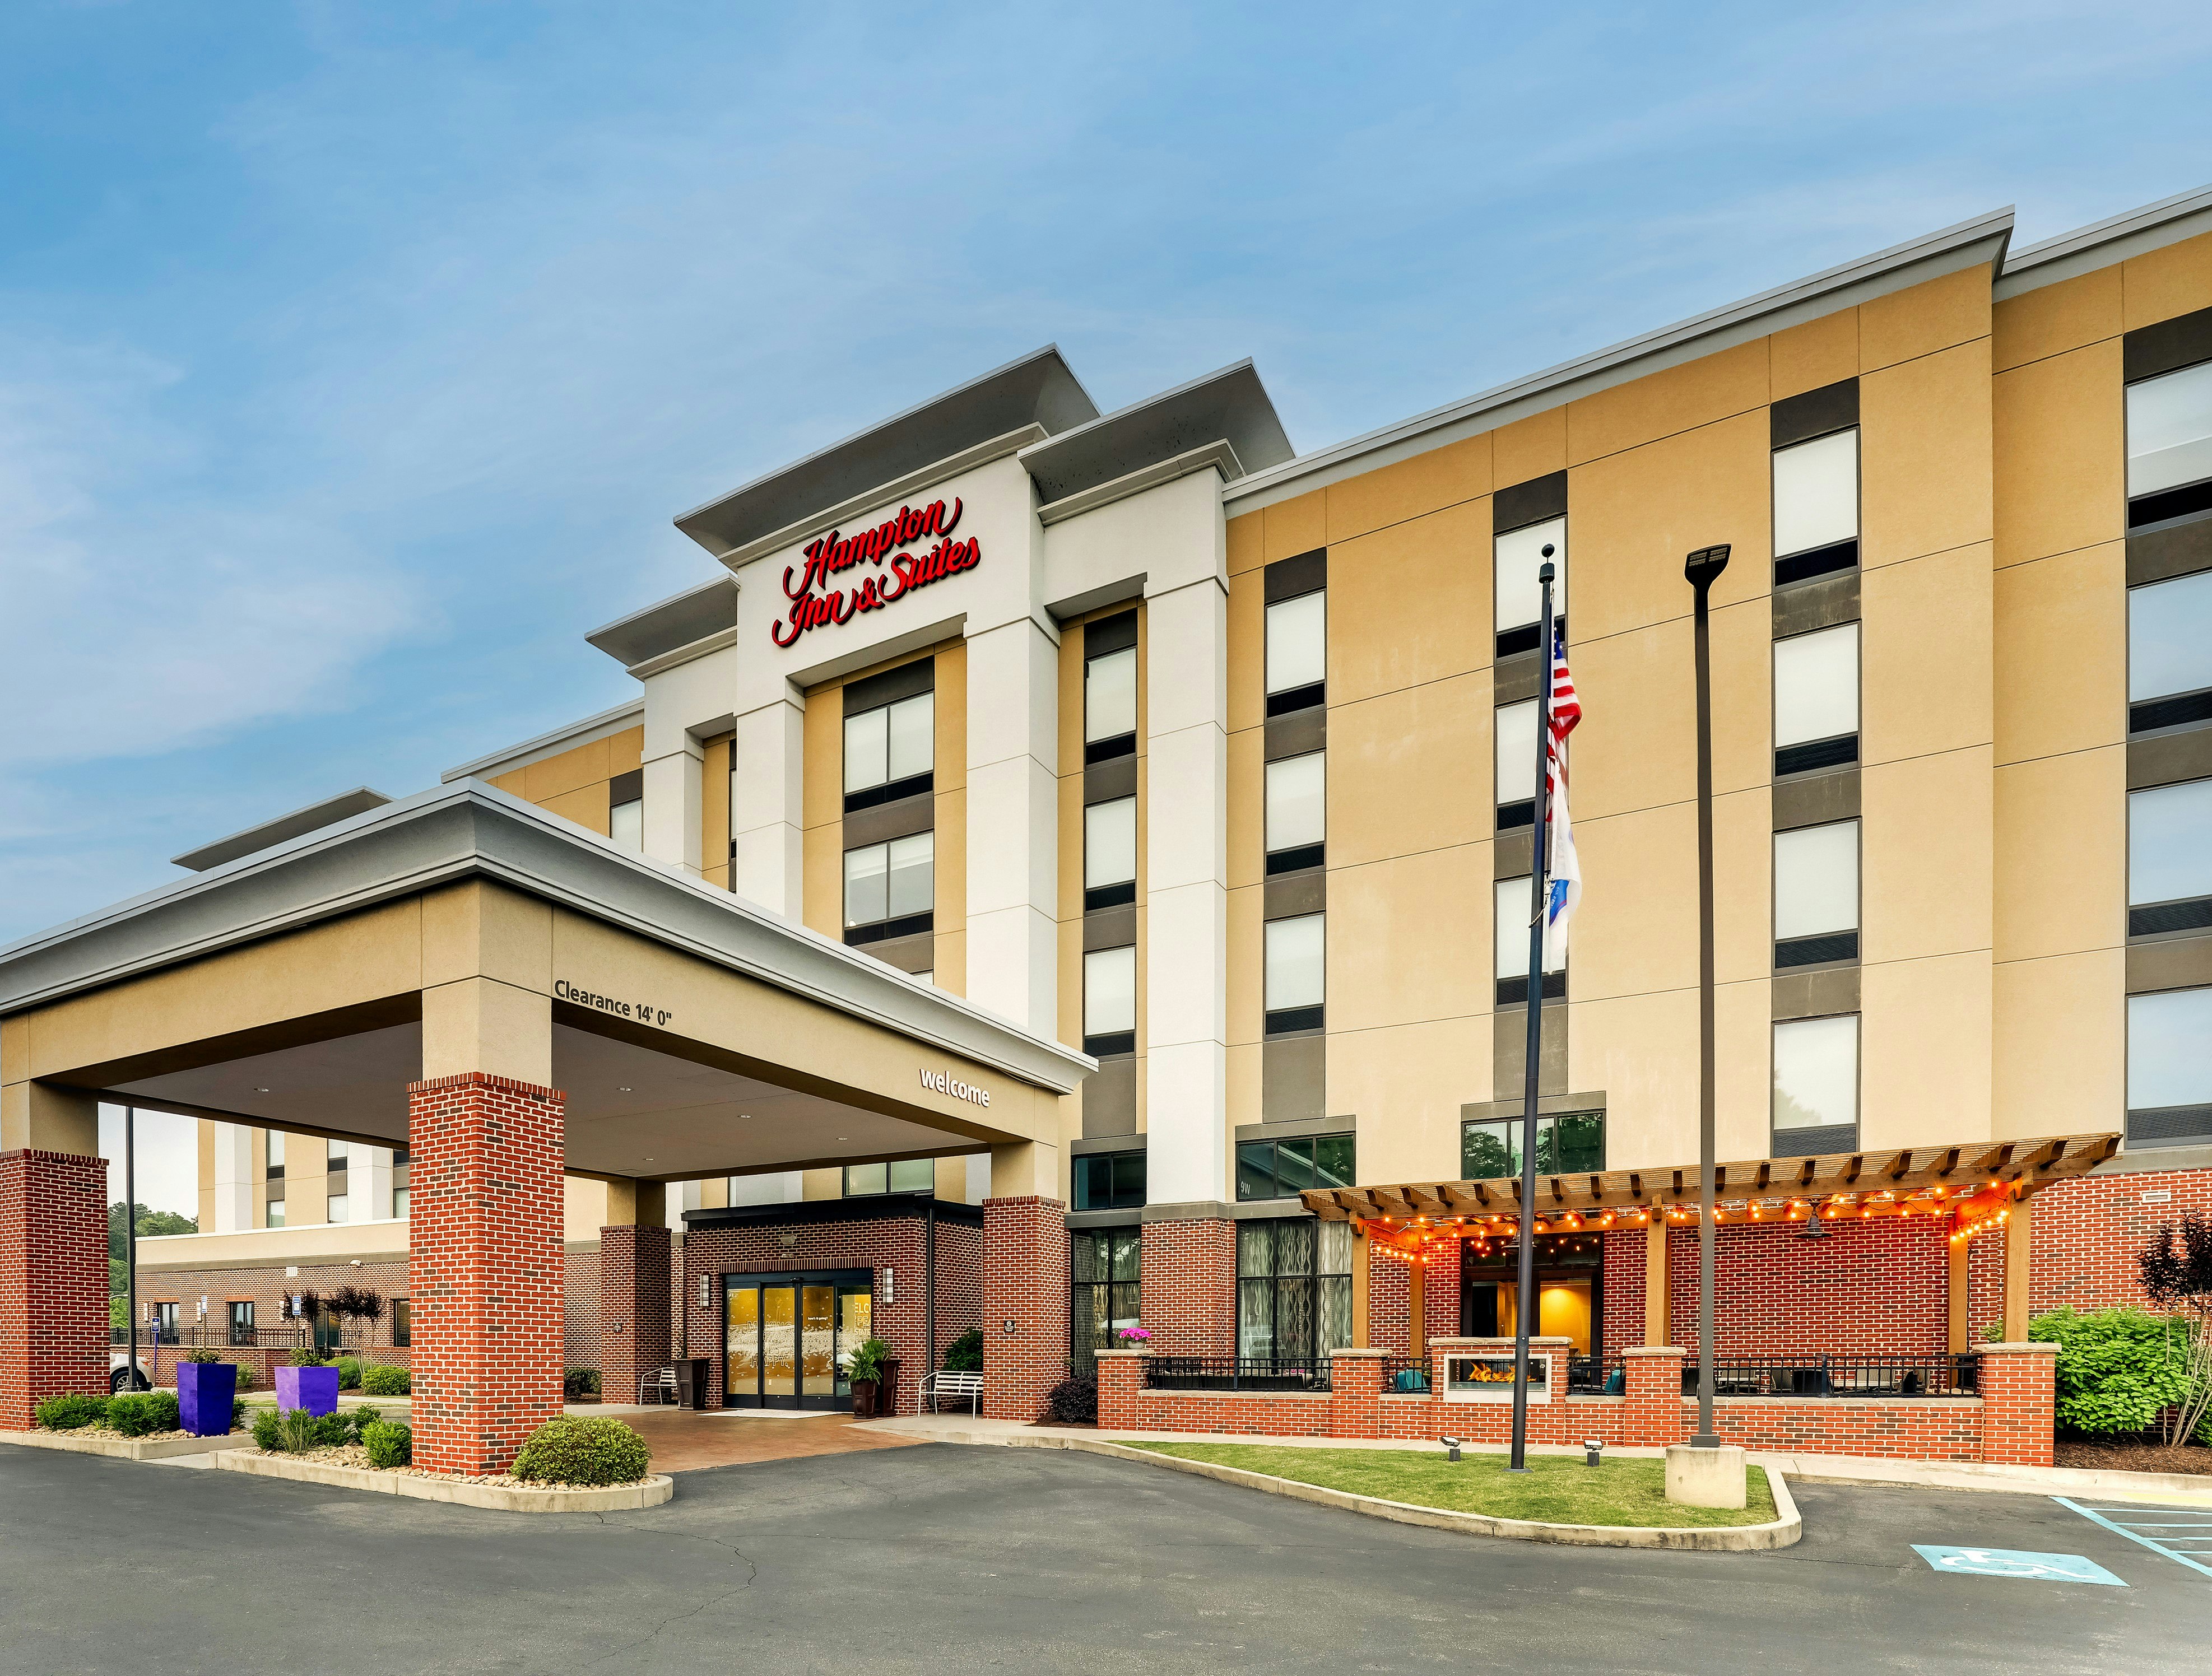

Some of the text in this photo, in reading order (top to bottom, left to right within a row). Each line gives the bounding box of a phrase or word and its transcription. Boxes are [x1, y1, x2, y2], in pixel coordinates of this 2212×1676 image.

[783, 496, 963, 600] Hampton
[772, 536, 981, 648] Inn & Suites
[555, 980, 672, 1026] Clearance 14' 0"
[919, 1068, 991, 1107] welcome
[747, 1321, 792, 1333] MKING
